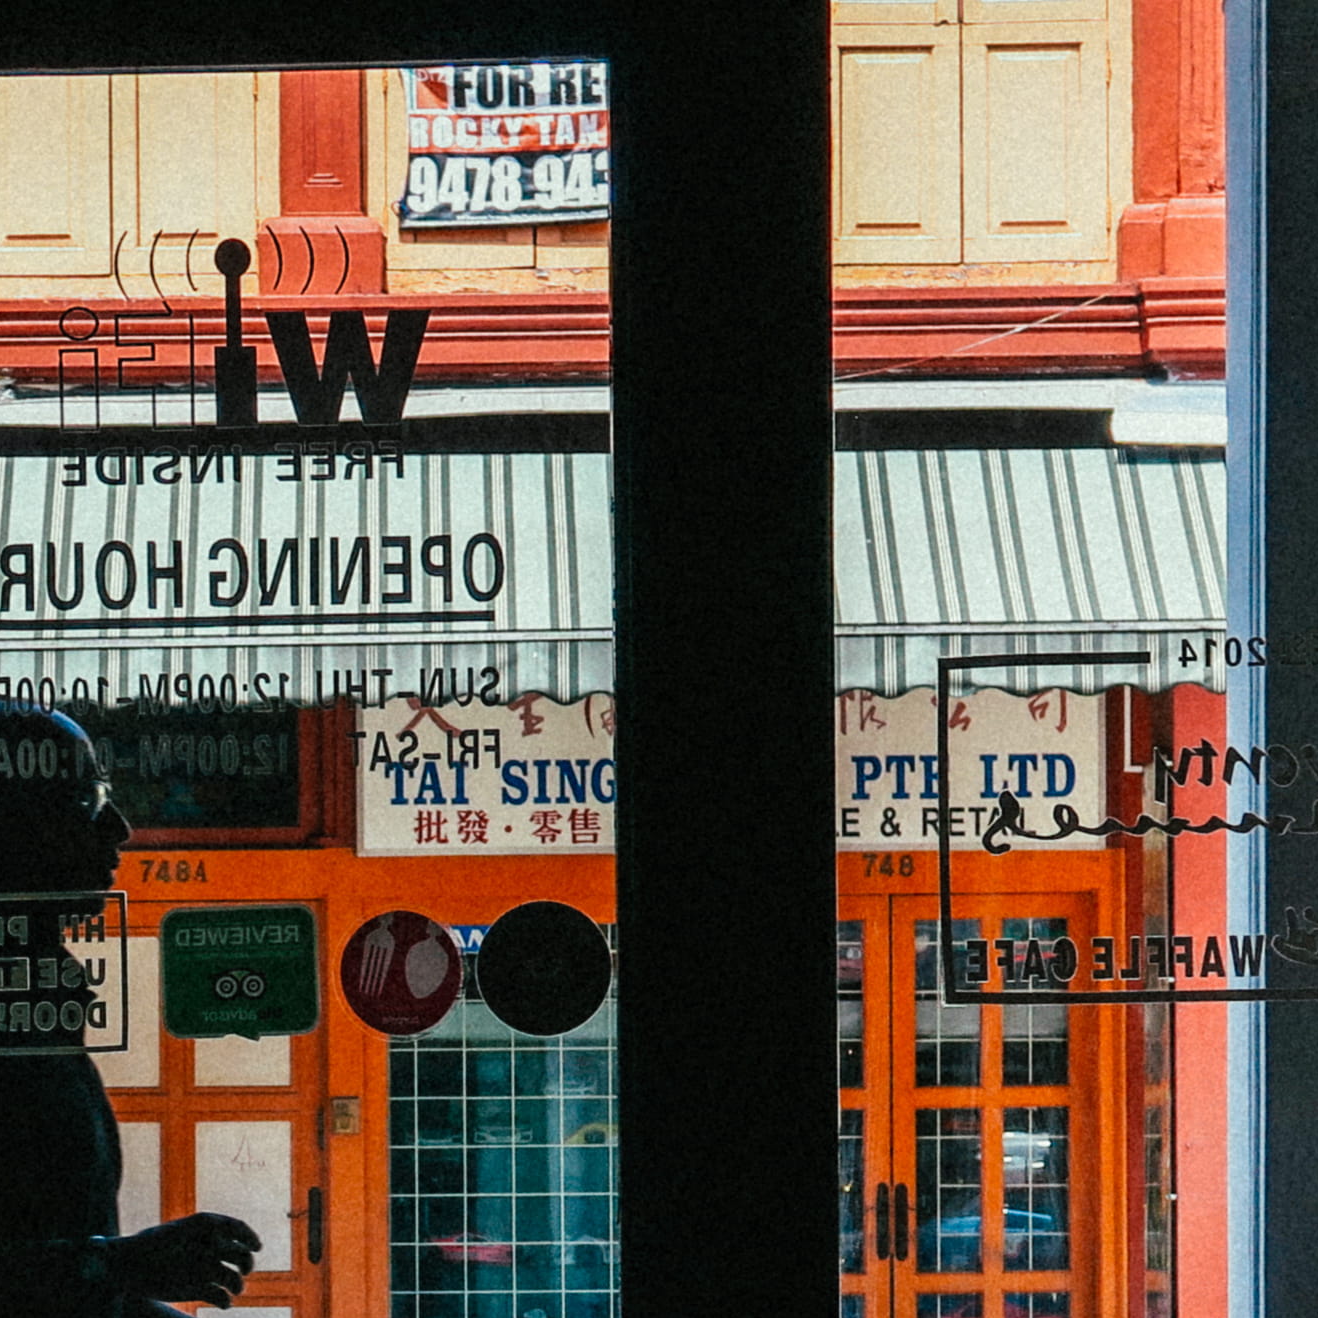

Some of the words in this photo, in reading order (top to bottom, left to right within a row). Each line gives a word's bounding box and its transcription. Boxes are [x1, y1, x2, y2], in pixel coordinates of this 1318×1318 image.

[453, 66, 536, 109] FOR
[409, 114, 524, 149] ROCKY
[537, 113, 602, 147] TAN
[406, 155, 523, 213] 9478
[385, 760, 470, 806] TAI
[501, 759, 617, 805] SING
[979, 753, 1077, 799] LTD
[880, 806, 902, 837] &
[139, 857, 208, 884] 748A
[861, 854, 915, 878] 748
